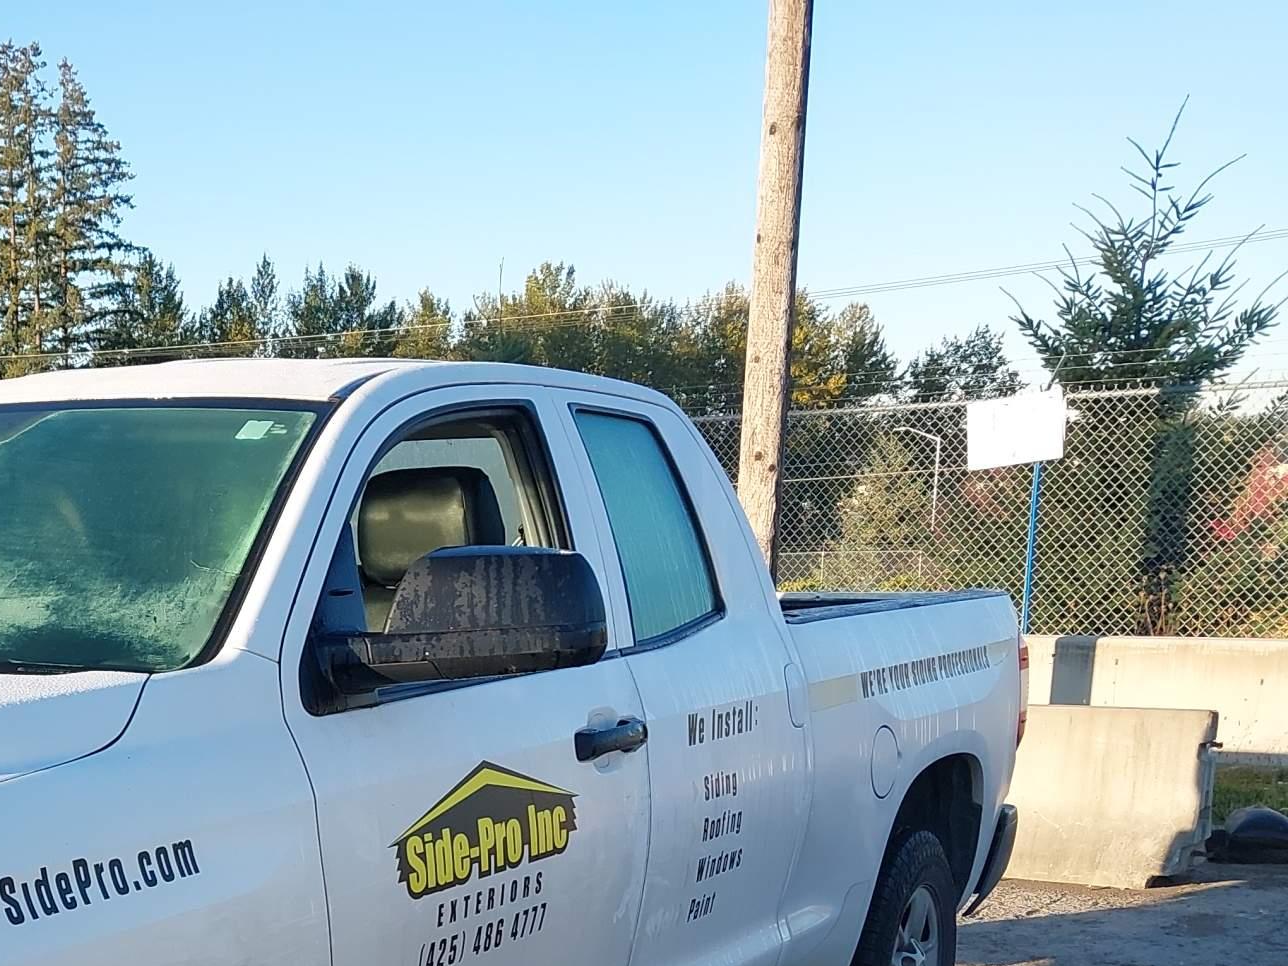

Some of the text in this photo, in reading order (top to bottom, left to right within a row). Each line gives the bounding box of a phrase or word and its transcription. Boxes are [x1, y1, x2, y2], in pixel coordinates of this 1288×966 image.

[861, 666, 889, 699] WE'RE
[889, 662, 912, 691] YOUR
[912, 656, 939, 687] SIDING
[688, 700, 759, 747] We Install:
[704, 771, 737, 801] Siding
[703, 810, 743, 842] Roofing
[406, 804, 569, 894] Side-Pro Inc
[696, 848, 743, 883] Windows
[437, 871, 543, 928] EXTERIORS
[472, 918, 505, 955] 486
[510, 902, 548, 941] 4777
